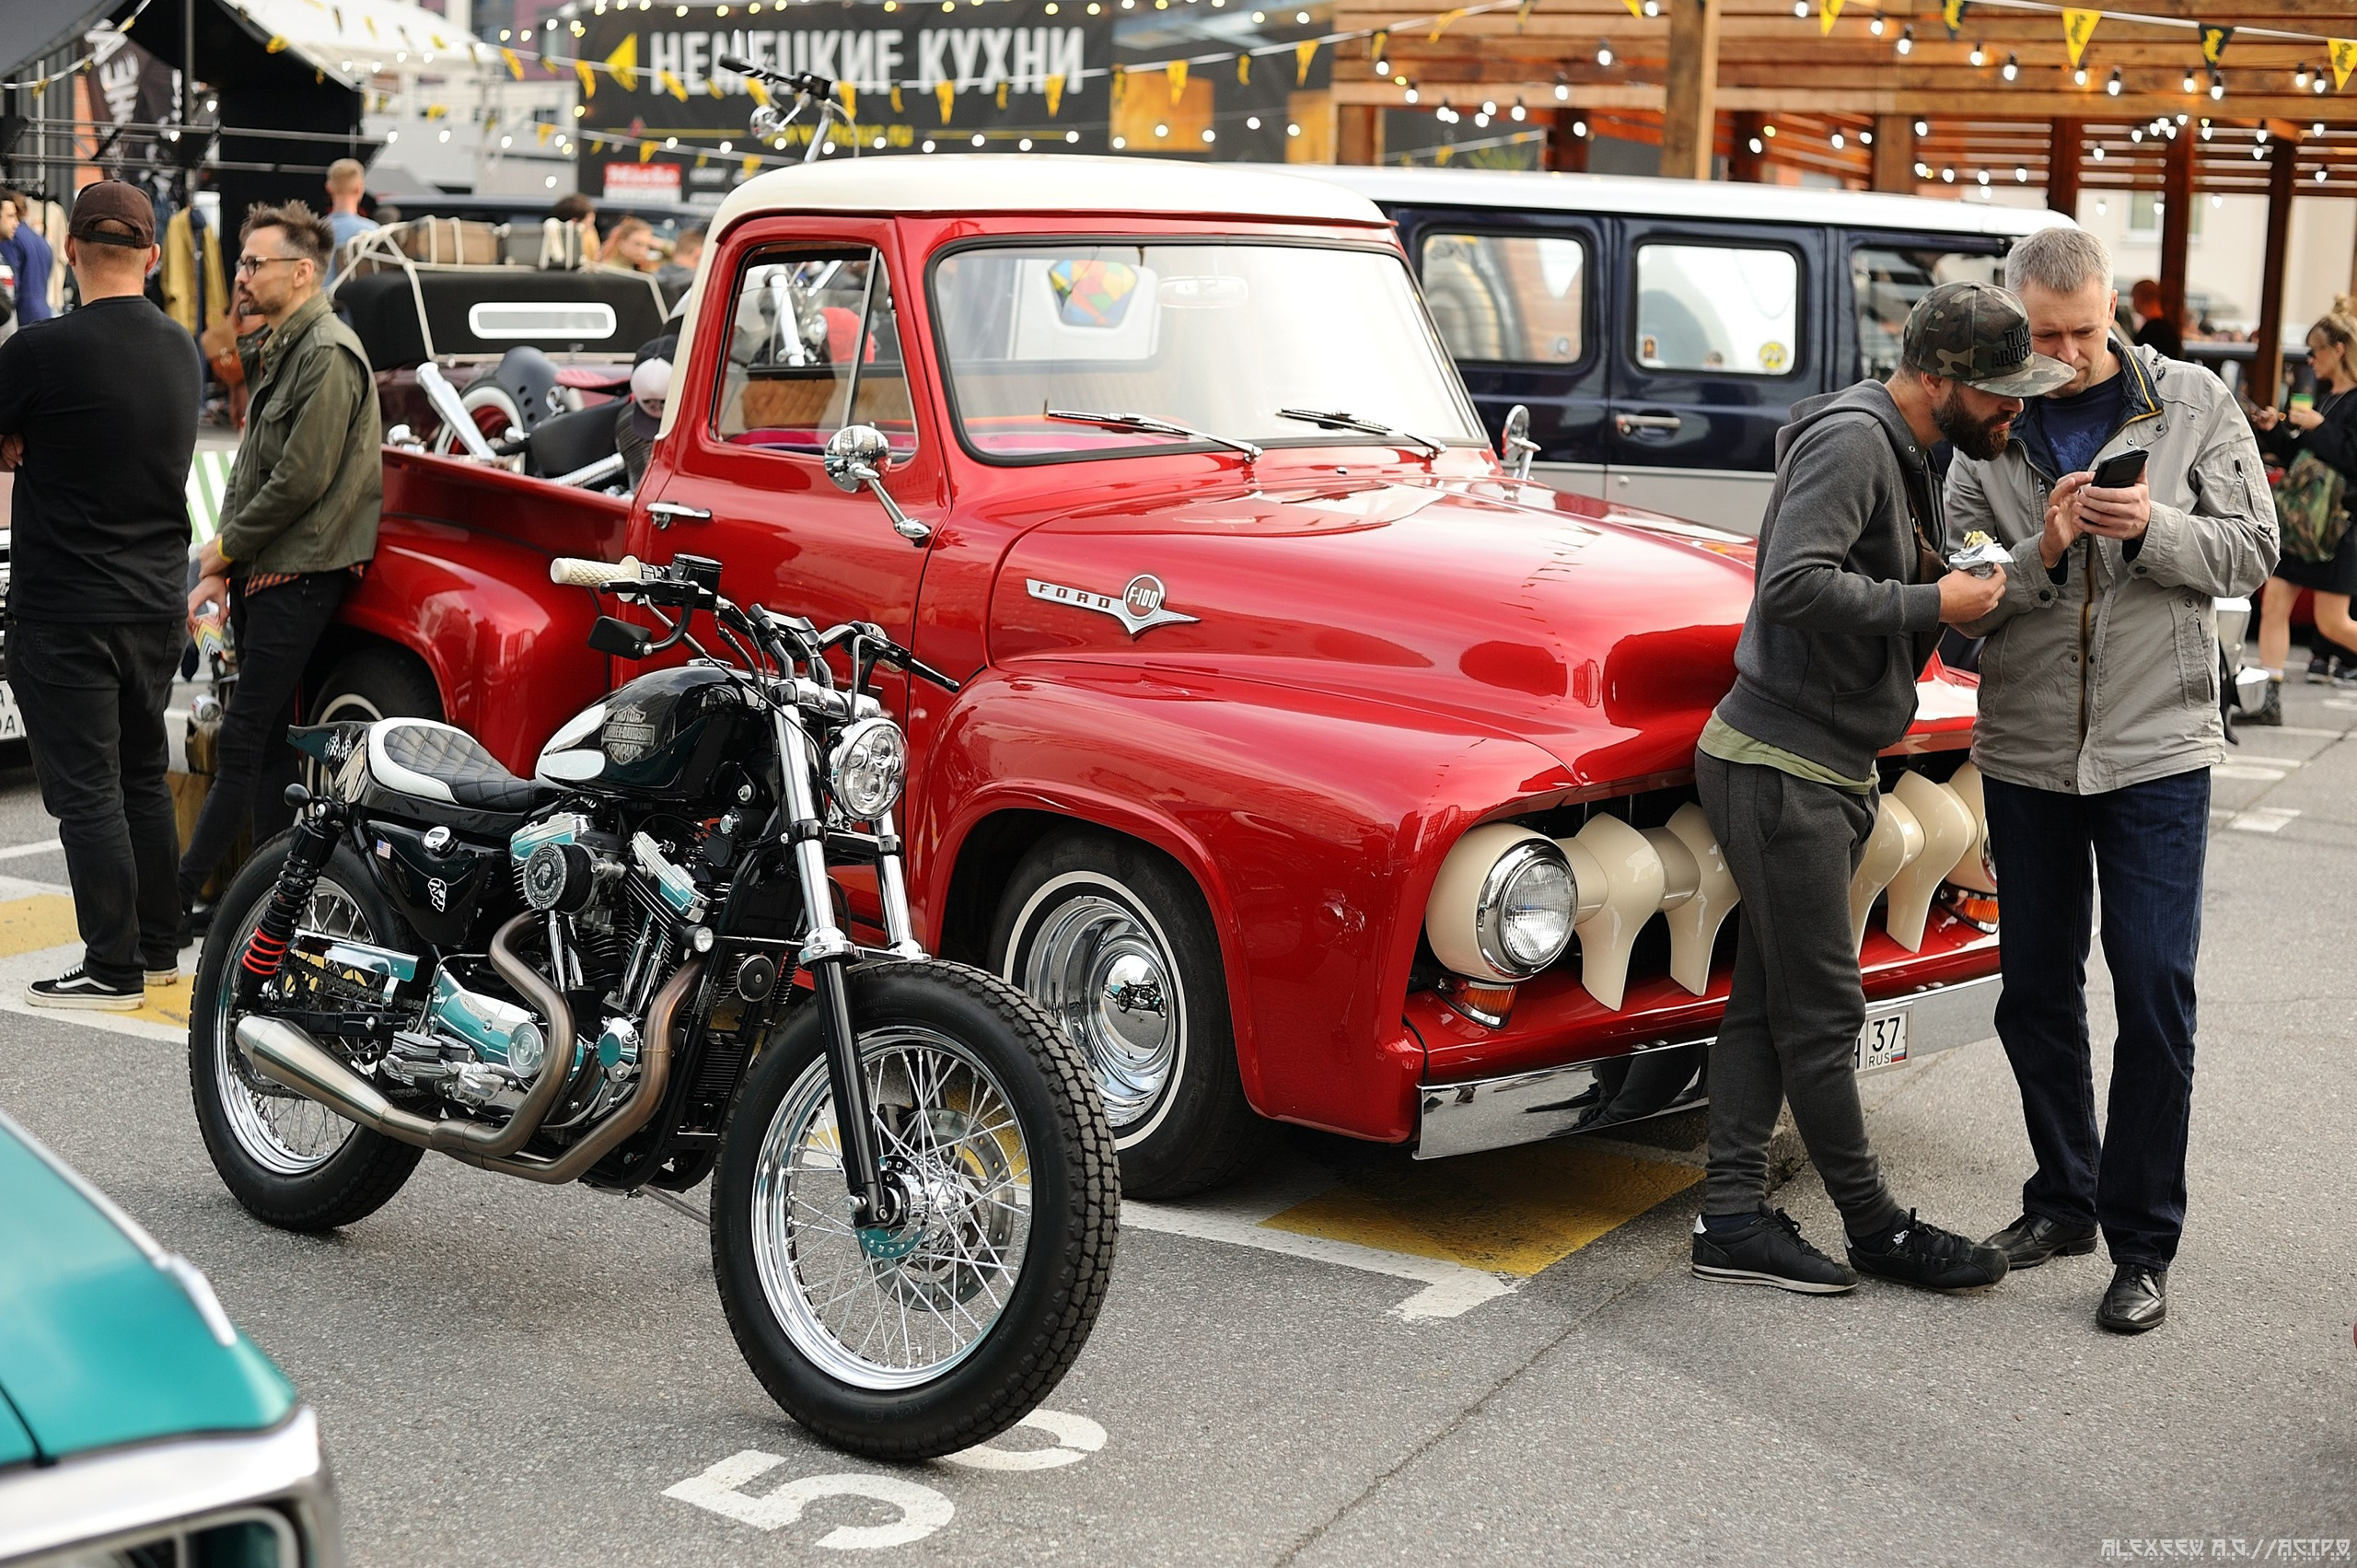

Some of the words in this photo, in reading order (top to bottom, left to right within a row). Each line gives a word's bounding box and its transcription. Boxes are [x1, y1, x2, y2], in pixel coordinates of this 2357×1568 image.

[918, 26, 1085, 95] КУХНИ
[1039, 584, 1110, 609] FORD
[1127, 586, 1159, 609] F-100
[1872, 1016, 1900, 1052] 37
[1868, 1051, 1890, 1067] RUS
